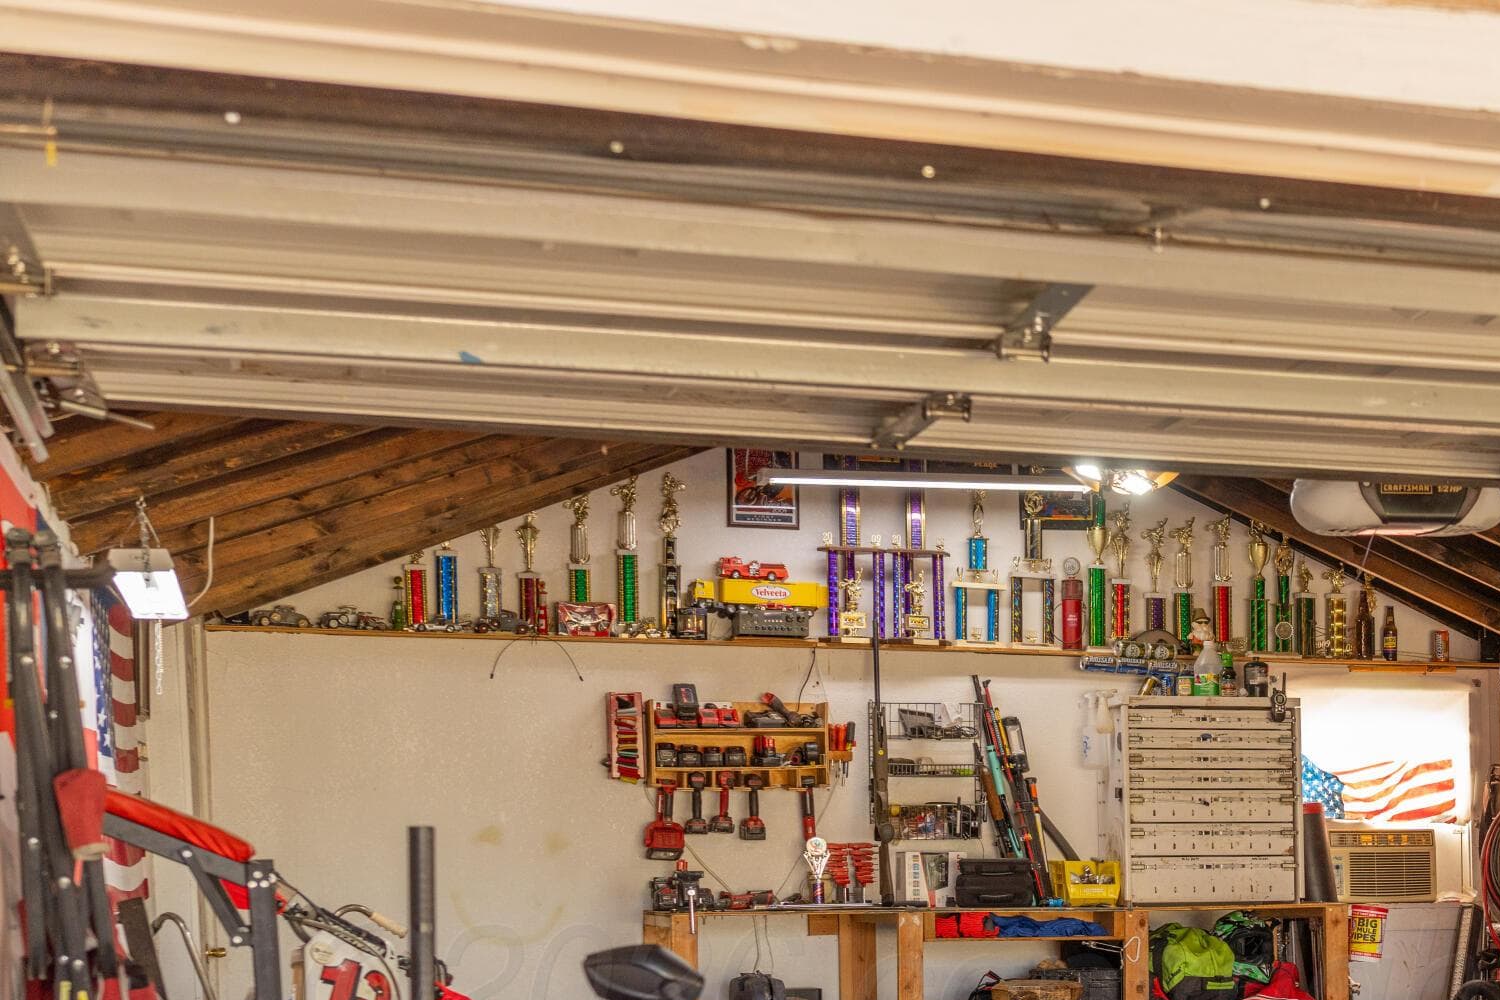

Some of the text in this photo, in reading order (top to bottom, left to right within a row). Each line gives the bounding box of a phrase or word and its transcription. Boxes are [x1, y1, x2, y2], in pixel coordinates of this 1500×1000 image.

[1383, 484, 1430, 492] CRAFTSMAN
[755, 587, 787, 597] Velveeta
[1357, 918, 1378, 929] BIG
[1356, 927, 1377, 935] MULE
